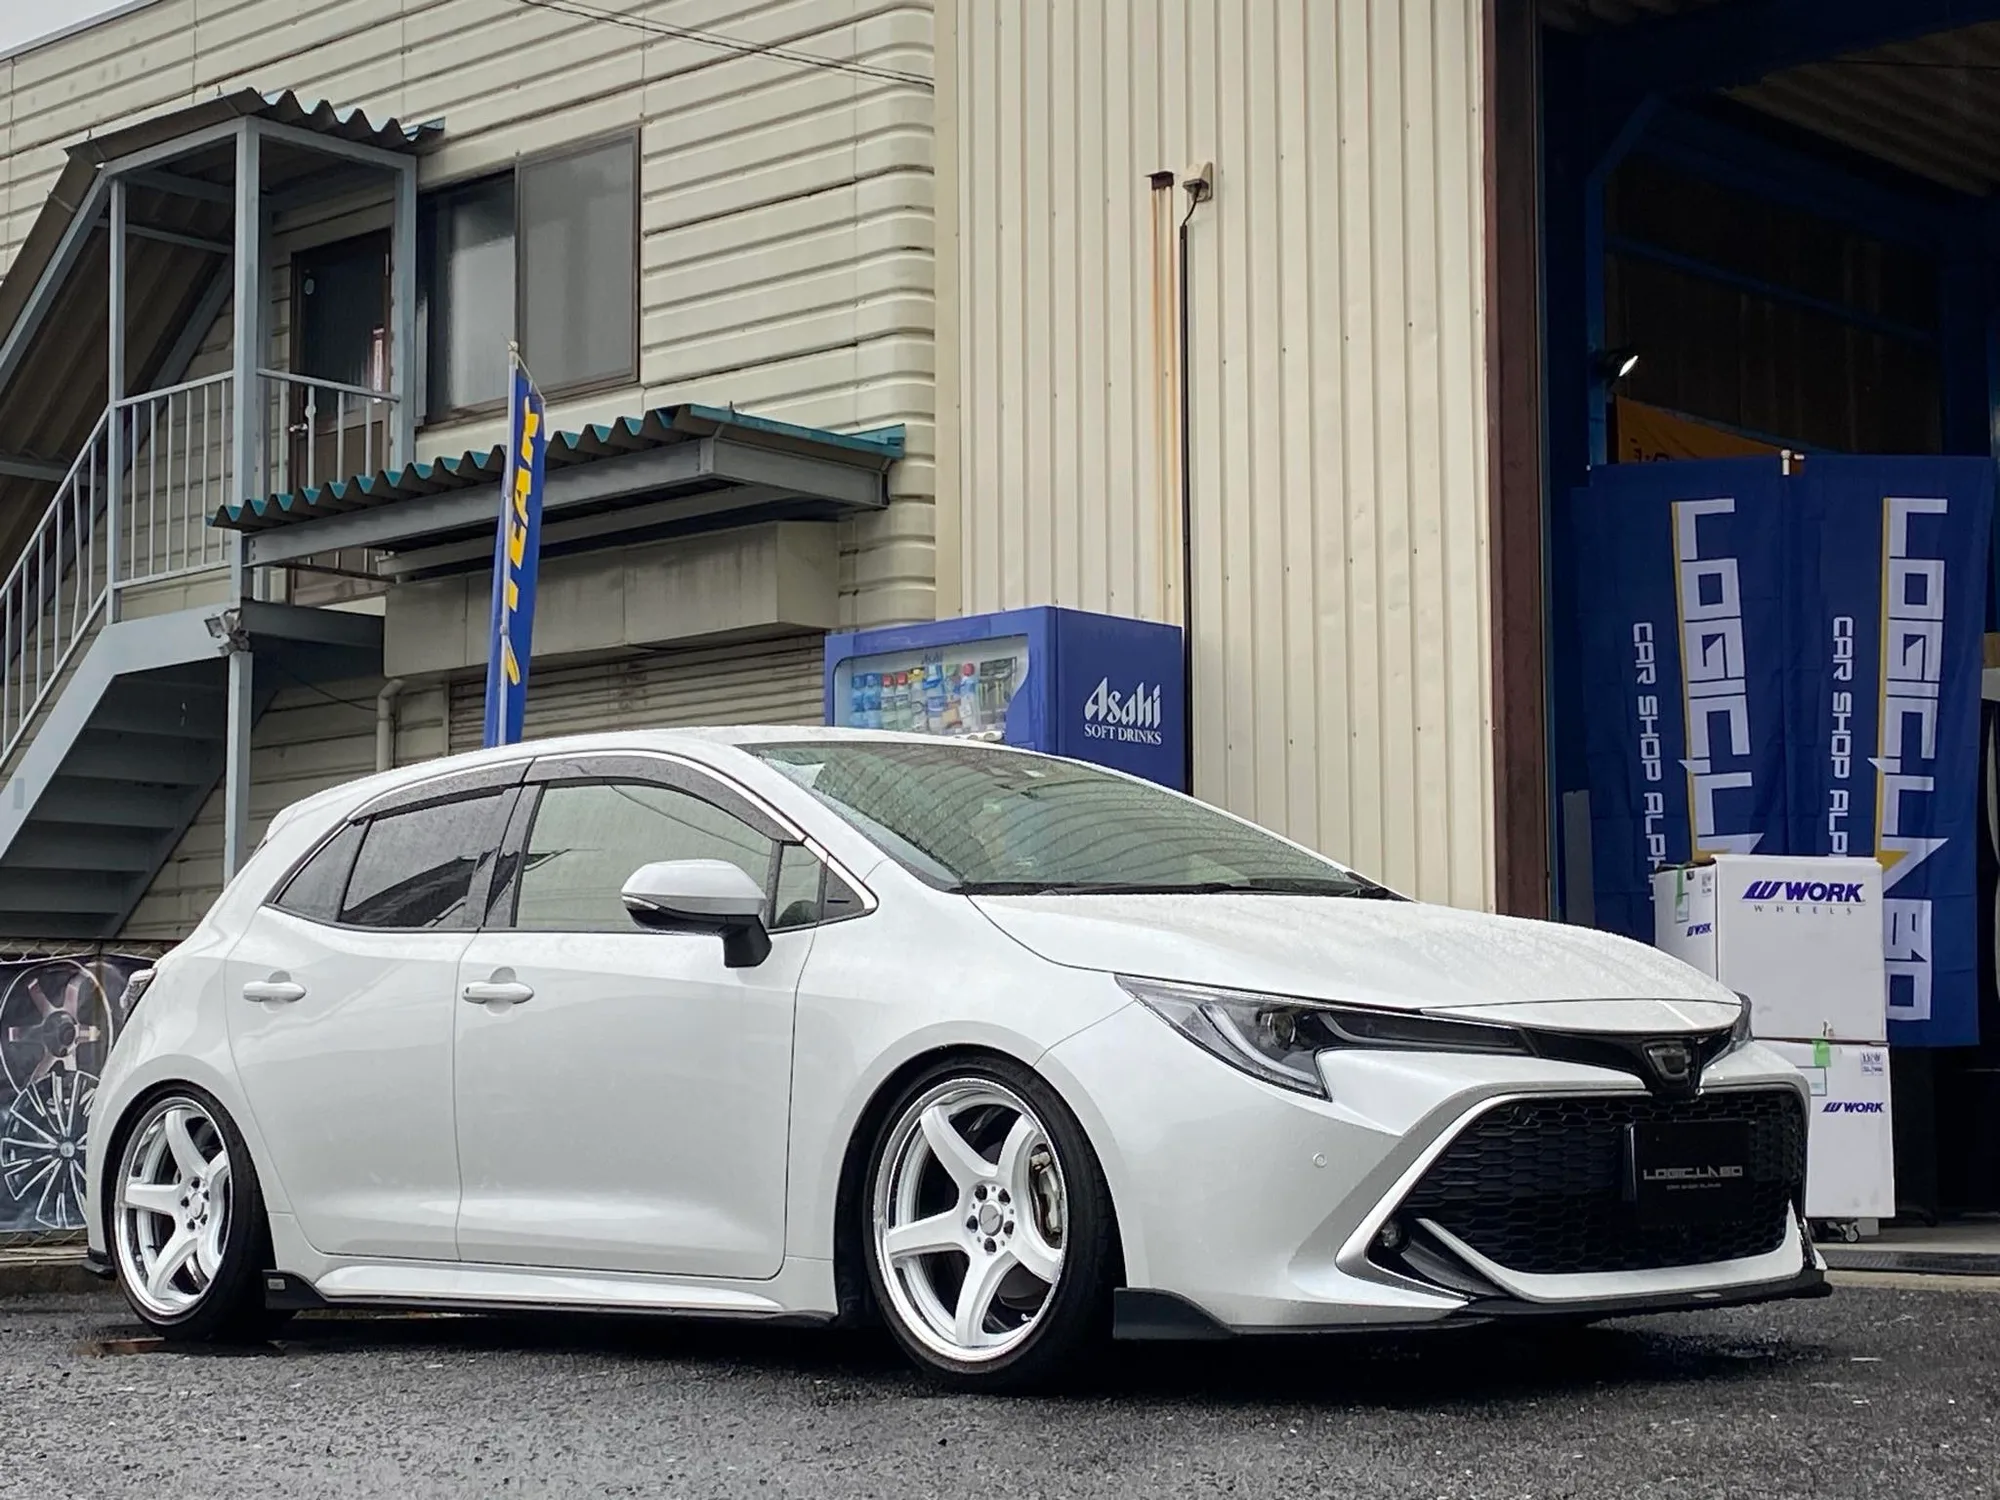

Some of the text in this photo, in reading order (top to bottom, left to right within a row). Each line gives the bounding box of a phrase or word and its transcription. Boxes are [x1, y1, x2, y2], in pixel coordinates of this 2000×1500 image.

[1633, 622, 1656, 685] CAR
[1833, 617, 1853, 681] CAR
[1084, 676, 1161, 729] Asahi
[1084, 723, 1162, 745] SOFT DRINKS
[1638, 696, 1662, 782] SHOP
[1831, 692, 1851, 779] SHOP
